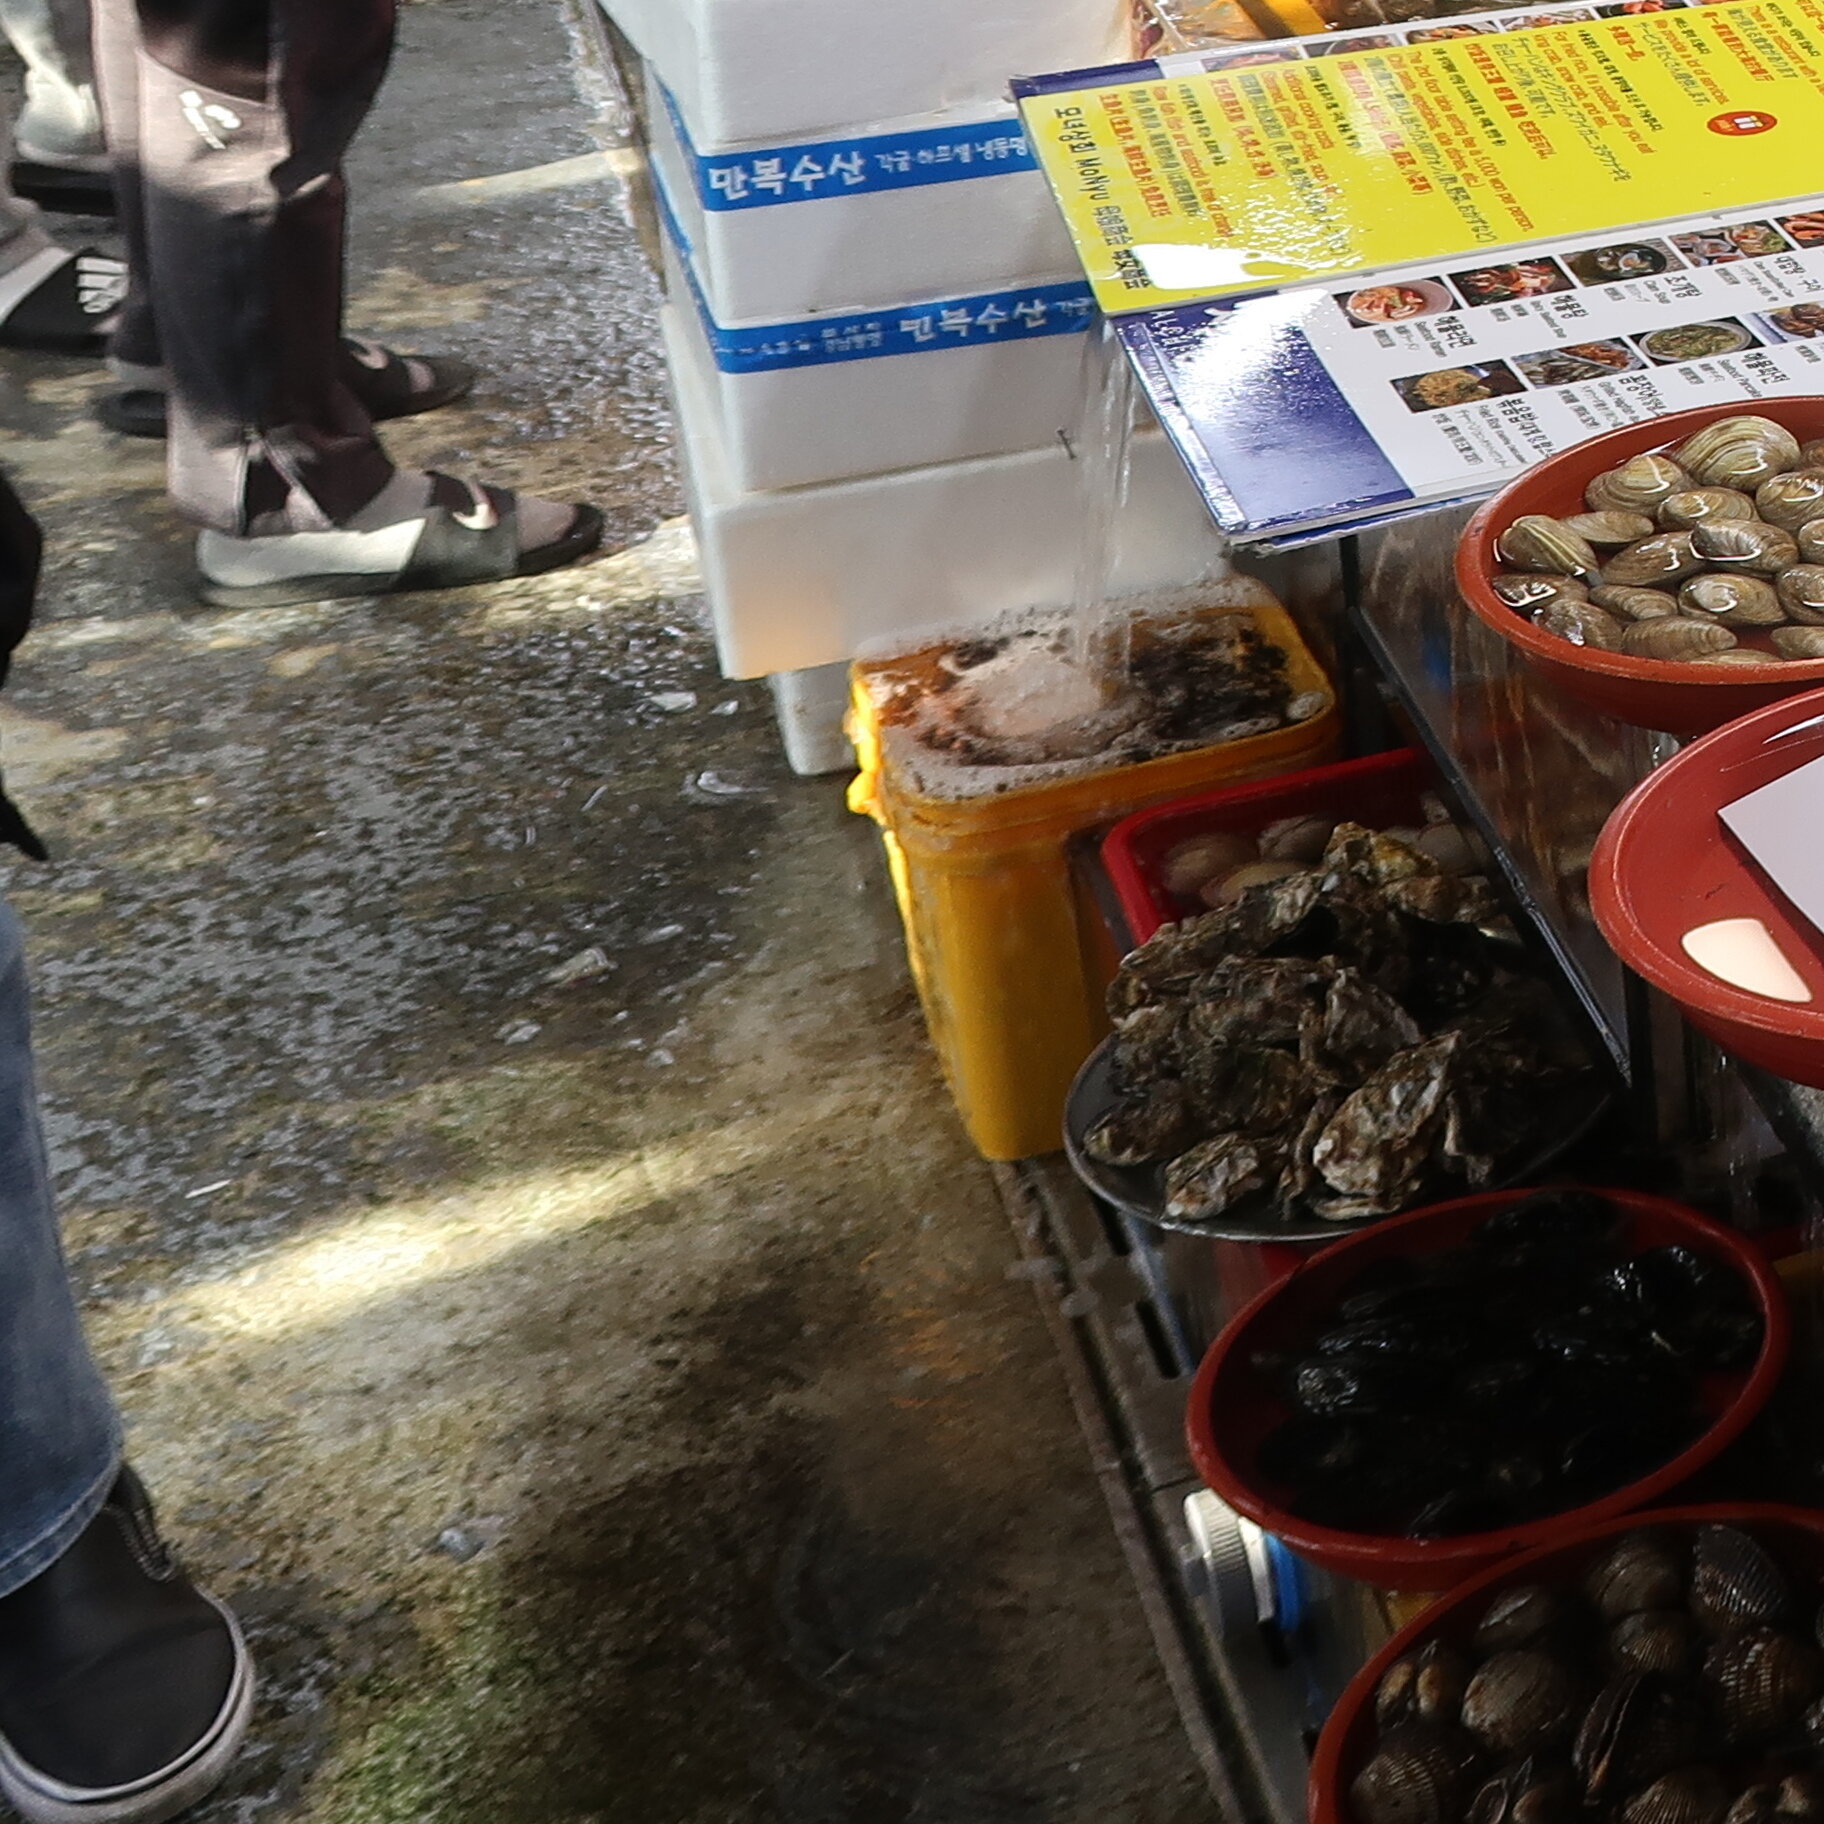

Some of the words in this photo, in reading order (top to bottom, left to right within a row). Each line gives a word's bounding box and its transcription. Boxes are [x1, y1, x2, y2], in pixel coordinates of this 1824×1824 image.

[1051, 104, 1097, 155] 모녀상회
[709, 150, 867, 201] 만복수산
[1071, 156, 1115, 203] MoNyu
[1667, 274, 1704, 300] 조개탕
[1435, 315, 1480, 349] 해물라면
